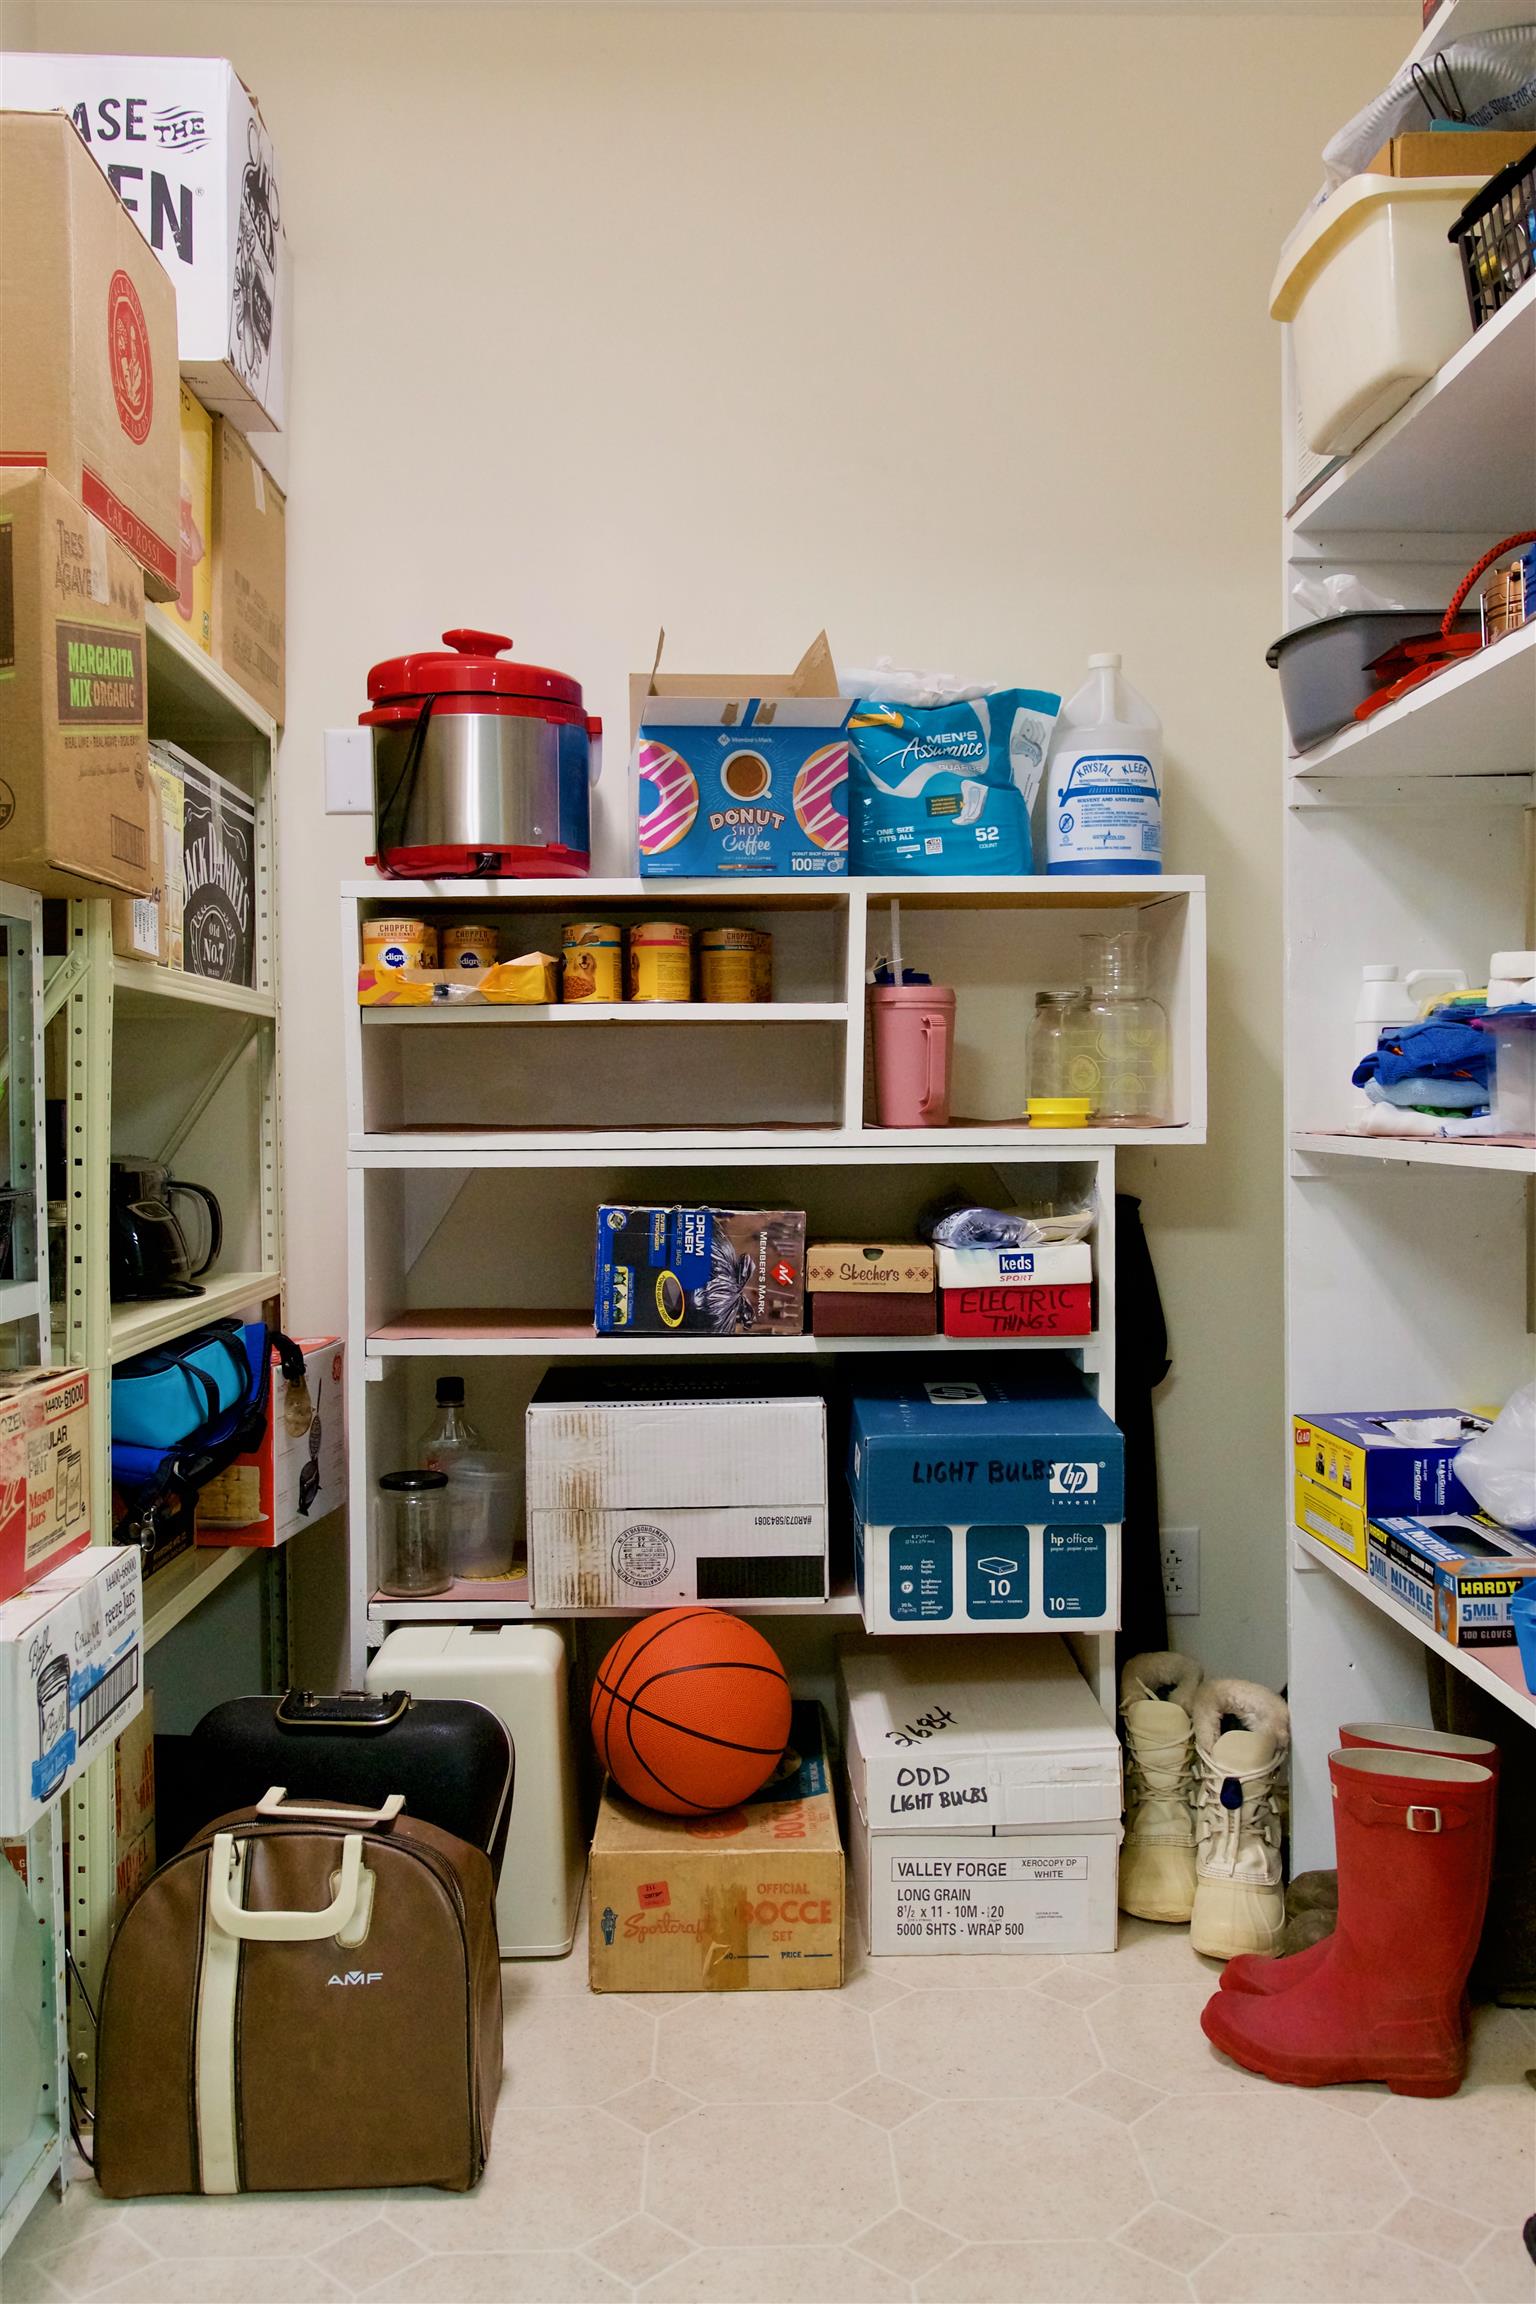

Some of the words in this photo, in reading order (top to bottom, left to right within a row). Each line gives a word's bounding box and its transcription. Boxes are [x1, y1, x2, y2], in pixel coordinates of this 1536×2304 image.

[52, 98, 148, 143] ASE
[153, 117, 206, 143] THE
[106, 498, 134, 541] CARLO
[136, 525, 161, 565] ROSSI
[68, 641, 135, 678] MARGARITA
[69, 678, 93, 708] MIX
[93, 680, 136, 708] ORGANIC
[926, 730, 978, 744] MEN'S
[877, 737, 984, 769] Assurance
[1076, 762, 1114, 778] KRYSTAL
[1121, 763, 1149, 777] KLEER
[709, 807, 786, 832] DONUT
[732, 826, 764, 836] SHOP
[876, 828, 894, 836] ONE
[896, 826, 915, 834] SIZE
[879, 835, 897, 844] FITS
[899, 833, 915, 841] ALL
[975, 826, 1000, 842] 52
[722, 834, 771, 856] Coffee
[791, 858, 812, 871] 100
[208, 822, 250, 933] DANIEL'S
[208, 922, 220, 938] Old
[379, 924, 414, 933] CHOPPED
[455, 930, 488, 938] CHOPPED
[684, 1213, 694, 1254] LINER
[695, 1214, 706, 1257] DRUM
[758, 1231, 768, 1283] MEMBER'S
[1001, 1255, 1032, 1271] keds
[839, 1263, 900, 1282] Skechers
[999, 1274, 1033, 1282] SPORT
[960, 1288, 1074, 1314] ELECTRIC
[982, 1312, 1060, 1332] THINGS
[1296, 1429, 1310, 1444] GLAD
[912, 1460, 979, 1484] LIGHT
[987, 1459, 1056, 1484] BULBS
[29, 1487, 55, 1512] Mason
[1051, 1498, 1097, 1506] invent
[28, 1509, 47, 1531] Jars
[1050, 1533, 1065, 1547] hp
[1066, 1532, 1094, 1544] office
[988, 1579, 1011, 1596] 10
[1390, 1567, 1433, 1612] NITRILE
[1461, 1581, 1517, 1595] HARDY
[122, 1589, 136, 1616] Jars
[1049, 1597, 1065, 1611] 10
[1463, 1630, 1478, 1640] 100
[1480, 1630, 1512, 1639] GLOVES
[29, 1625, 52, 1679] Ball
[885, 1705, 958, 1748] 2684
[897, 1766, 950, 1787] ODD
[890, 1792, 934, 1813] LIGHT
[940, 1787, 988, 1808] BULBS
[897, 1862, 952, 1877] VALLEY
[956, 1862, 1007, 1877] FORGE
[1021, 1859, 1065, 1867] XEROCOPY
[1066, 1859, 1077, 1867] DP
[1034, 1870, 1064, 1878] WHITE
[756, 1882, 810, 1896] OFFICIAL
[897, 1888, 931, 1902] LONG
[933, 1888, 971, 1901] GRAIN
[920, 1908, 928, 1918] x
[930, 1905, 943, 1918] 11
[954, 1905, 978, 1918] 10M
[990, 1905, 1005, 1918] 20
[623, 1911, 711, 1943] Sportcraf
[896, 1922, 923, 1936] 5000
[925, 1922, 957, 1936] SHTS
[967, 1922, 1002, 1936] WRAP
[1004, 1922, 1025, 1936] 500
[772, 1930, 793, 1942] SET
[781, 1951, 802, 1959] PRICE
[327, 1970, 384, 1986] AMF
